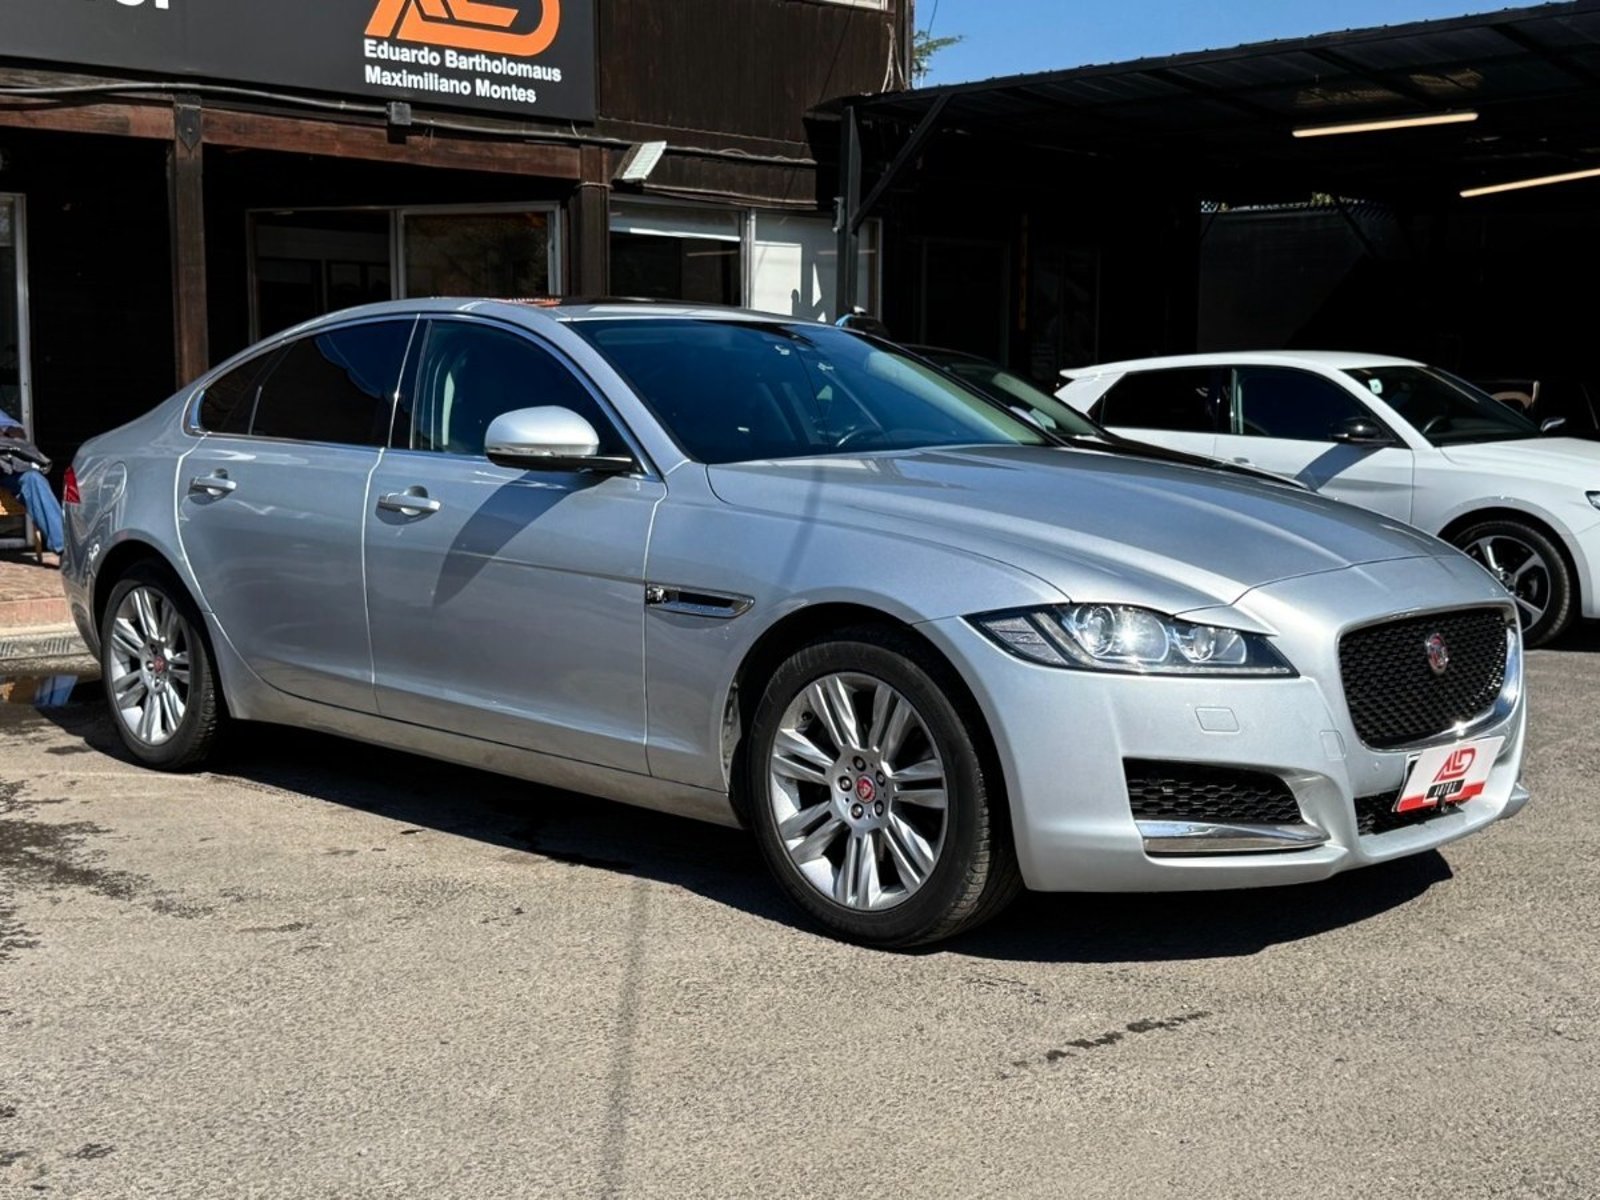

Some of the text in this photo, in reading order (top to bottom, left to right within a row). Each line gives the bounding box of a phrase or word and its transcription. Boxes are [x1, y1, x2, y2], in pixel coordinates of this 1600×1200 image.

[364, 39, 562, 82] Eduardo Bartholomaus
[365, 65, 537, 103] Maximiliano Montes
